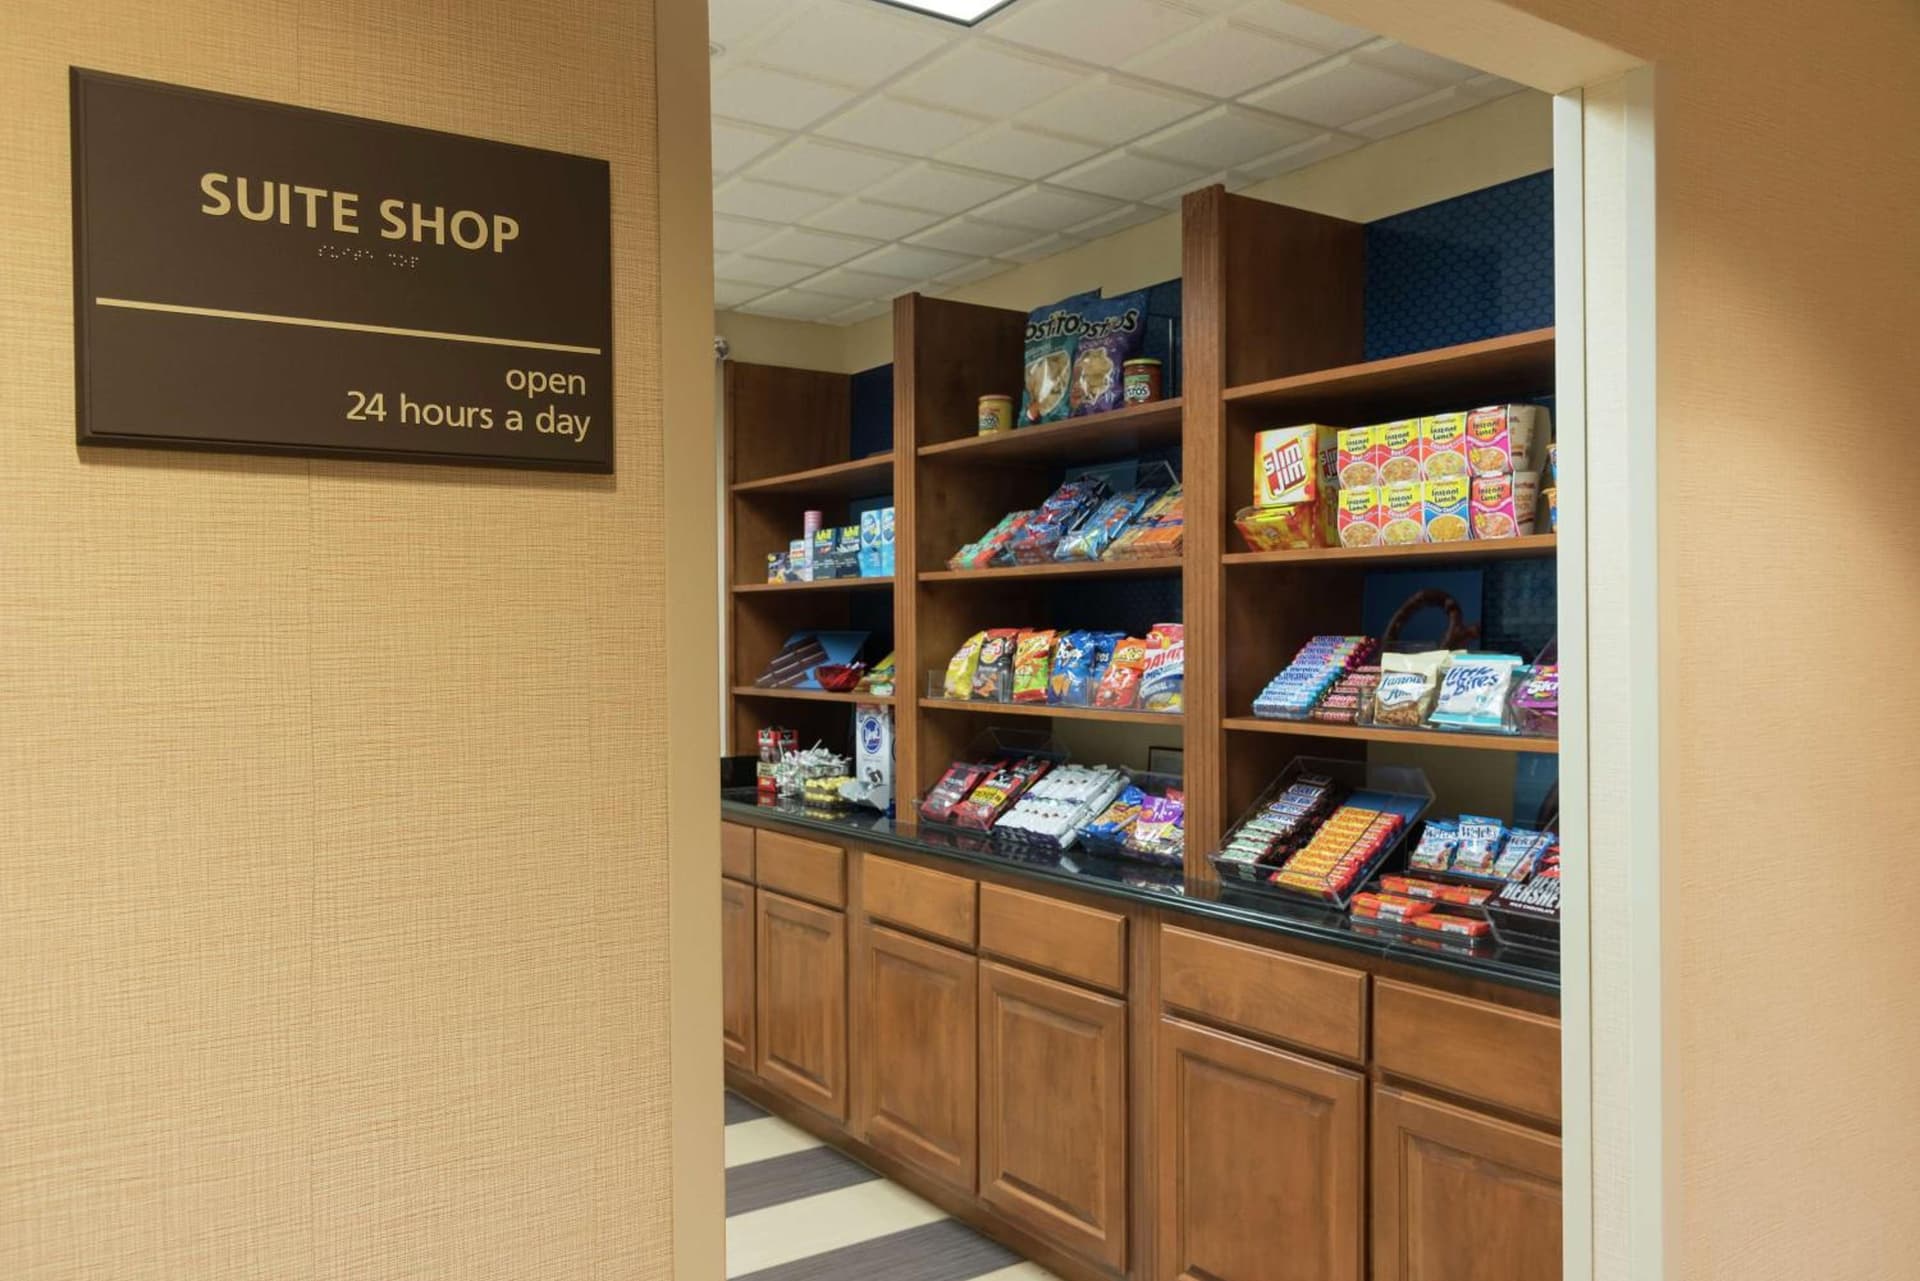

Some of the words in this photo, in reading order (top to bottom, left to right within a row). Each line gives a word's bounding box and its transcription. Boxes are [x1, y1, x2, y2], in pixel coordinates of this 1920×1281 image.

[199, 171, 360, 234] SUITE
[380, 200, 521, 253] SHOP
[506, 368, 587, 399] open
[346, 391, 388, 422] 24
[400, 393, 494, 431] hours
[506, 410, 523, 431] a
[535, 405, 591, 443] day
